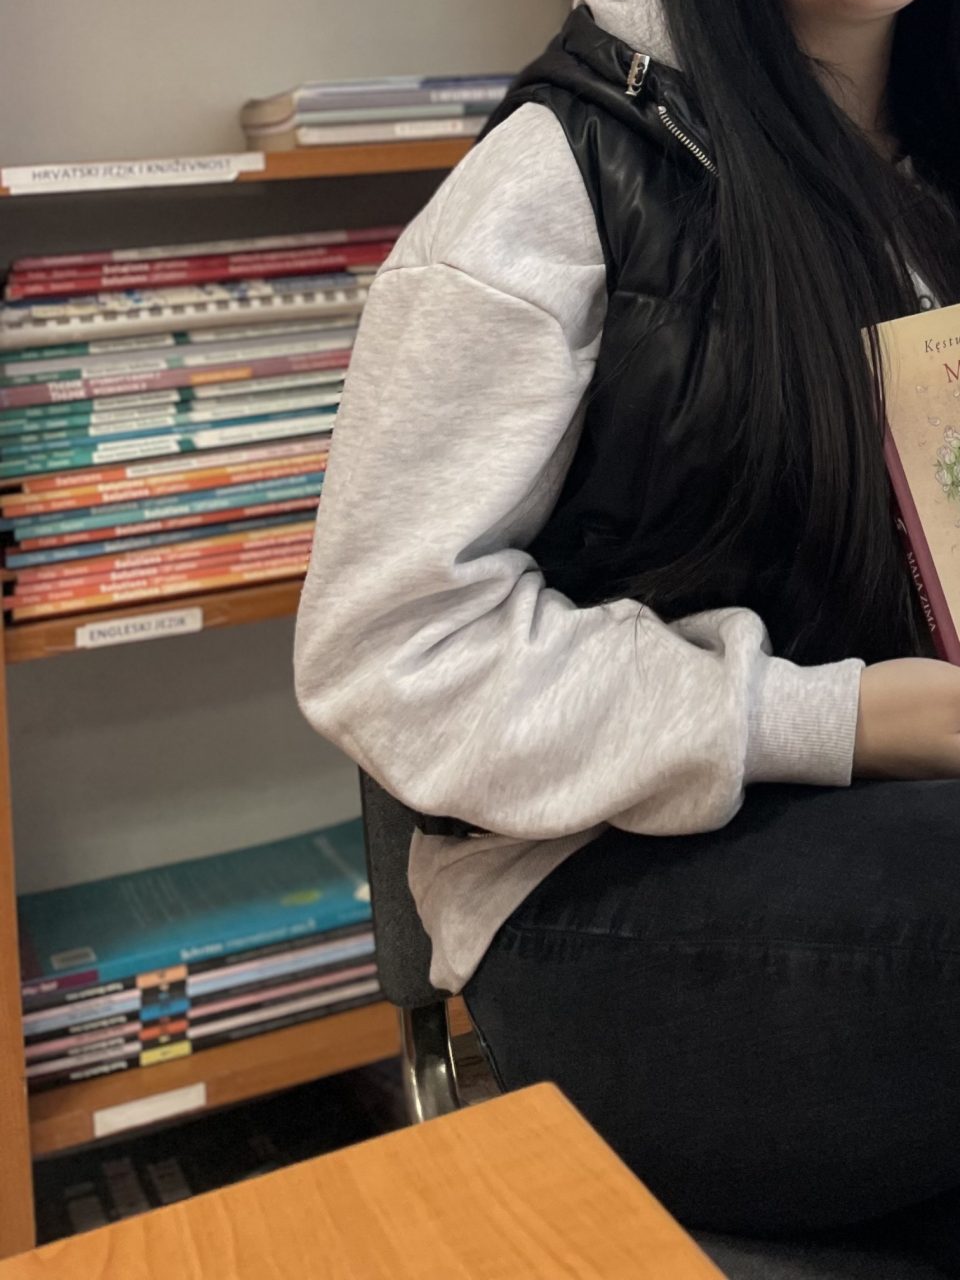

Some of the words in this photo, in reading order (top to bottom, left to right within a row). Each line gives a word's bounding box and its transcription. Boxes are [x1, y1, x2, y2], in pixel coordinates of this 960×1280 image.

[31, 167, 100, 182] HRVATSKI
[101, 164, 136, 180] JEZIK
[906, 551, 924, 592] MALA
[919, 594, 937, 633] ZIMA
[89, 620, 152, 642] ENGLESKI
